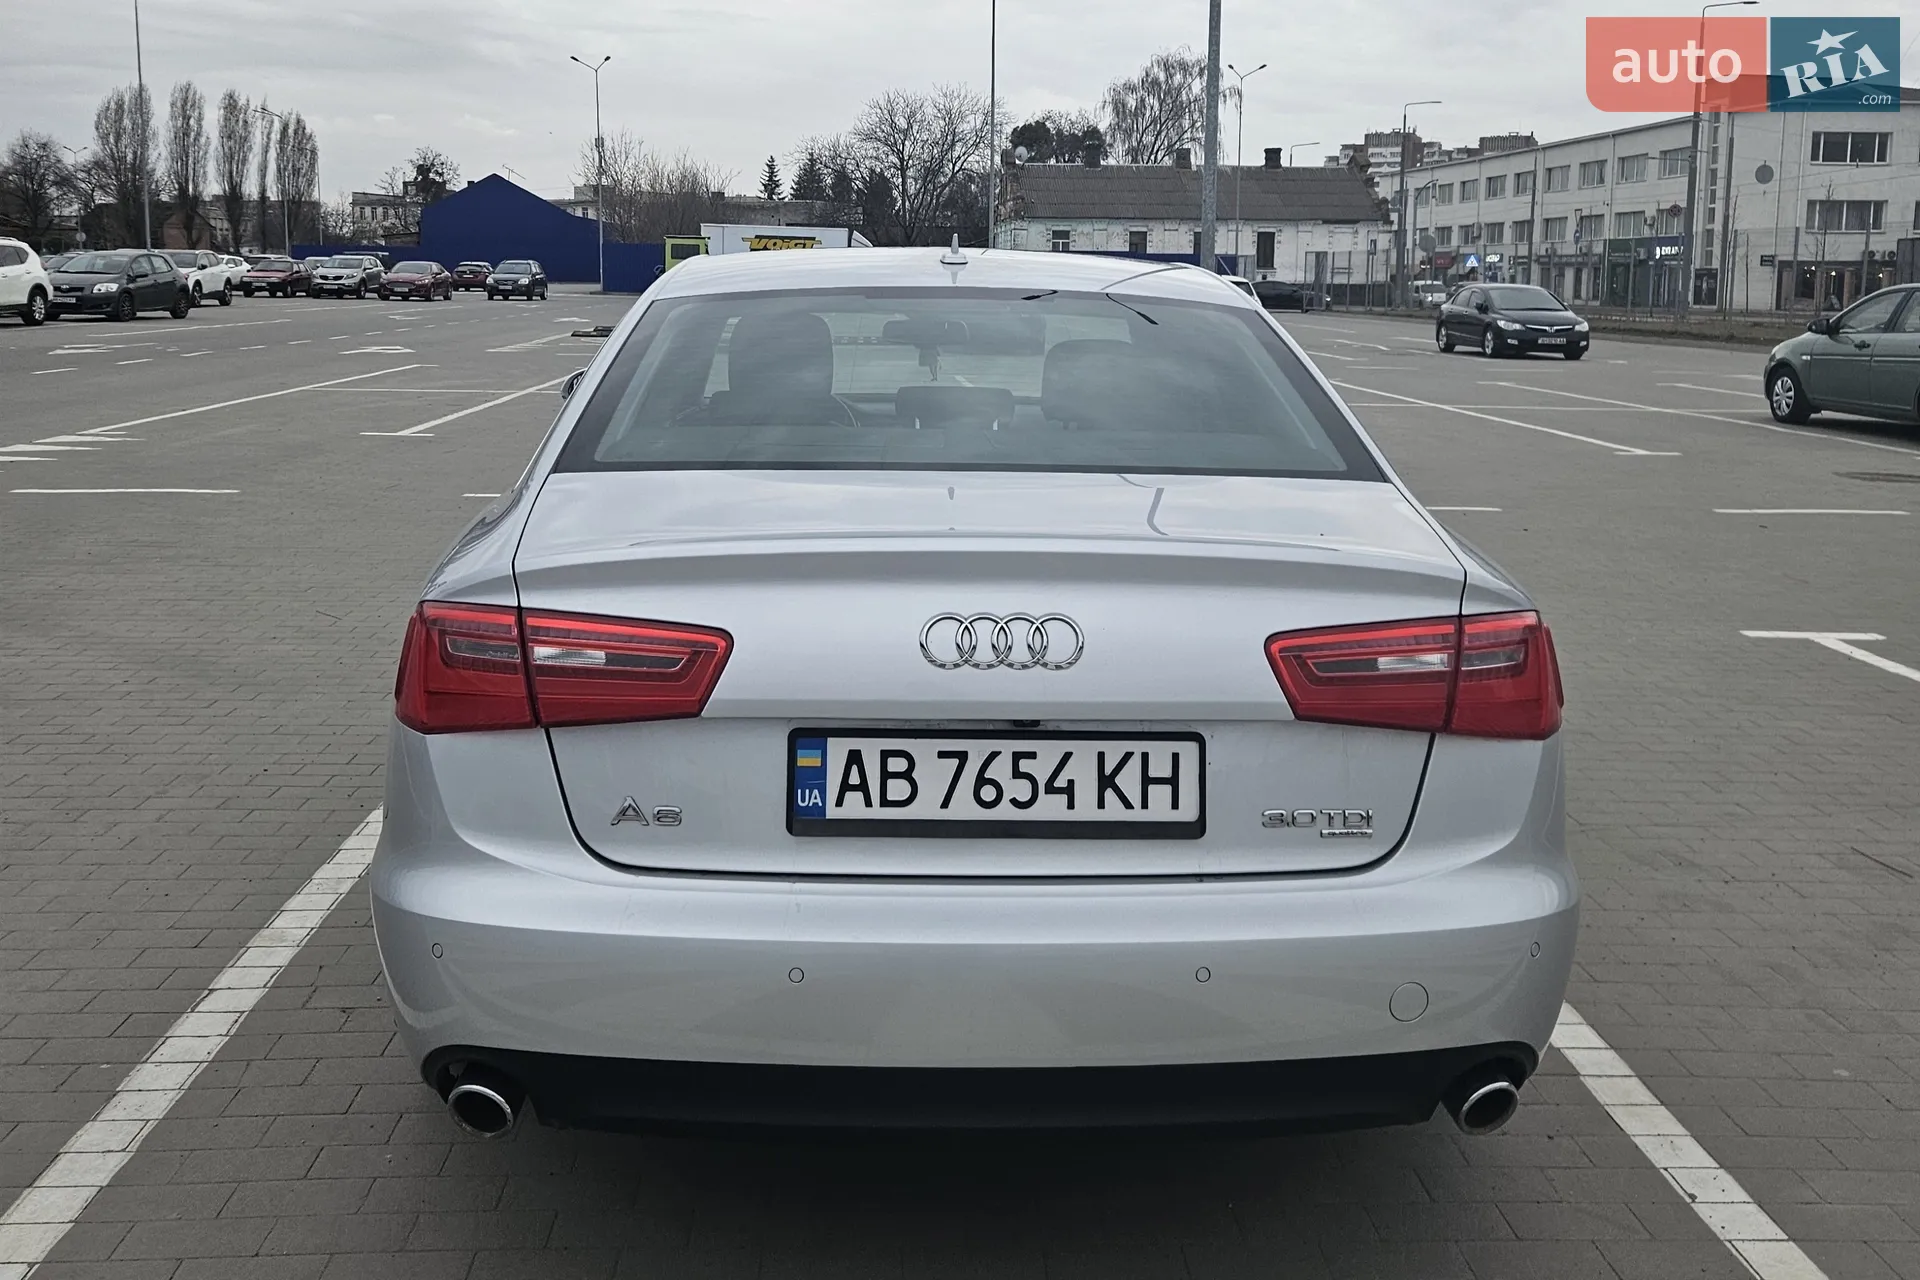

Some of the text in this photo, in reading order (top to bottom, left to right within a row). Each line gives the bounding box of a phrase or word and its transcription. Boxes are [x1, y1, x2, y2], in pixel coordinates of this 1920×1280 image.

[835, 749, 1180, 811] AB 7654 KH
[610, 795, 683, 827] A6
[797, 789, 822, 807] UA
[1261, 808, 1373, 829] 3.0 TDI
